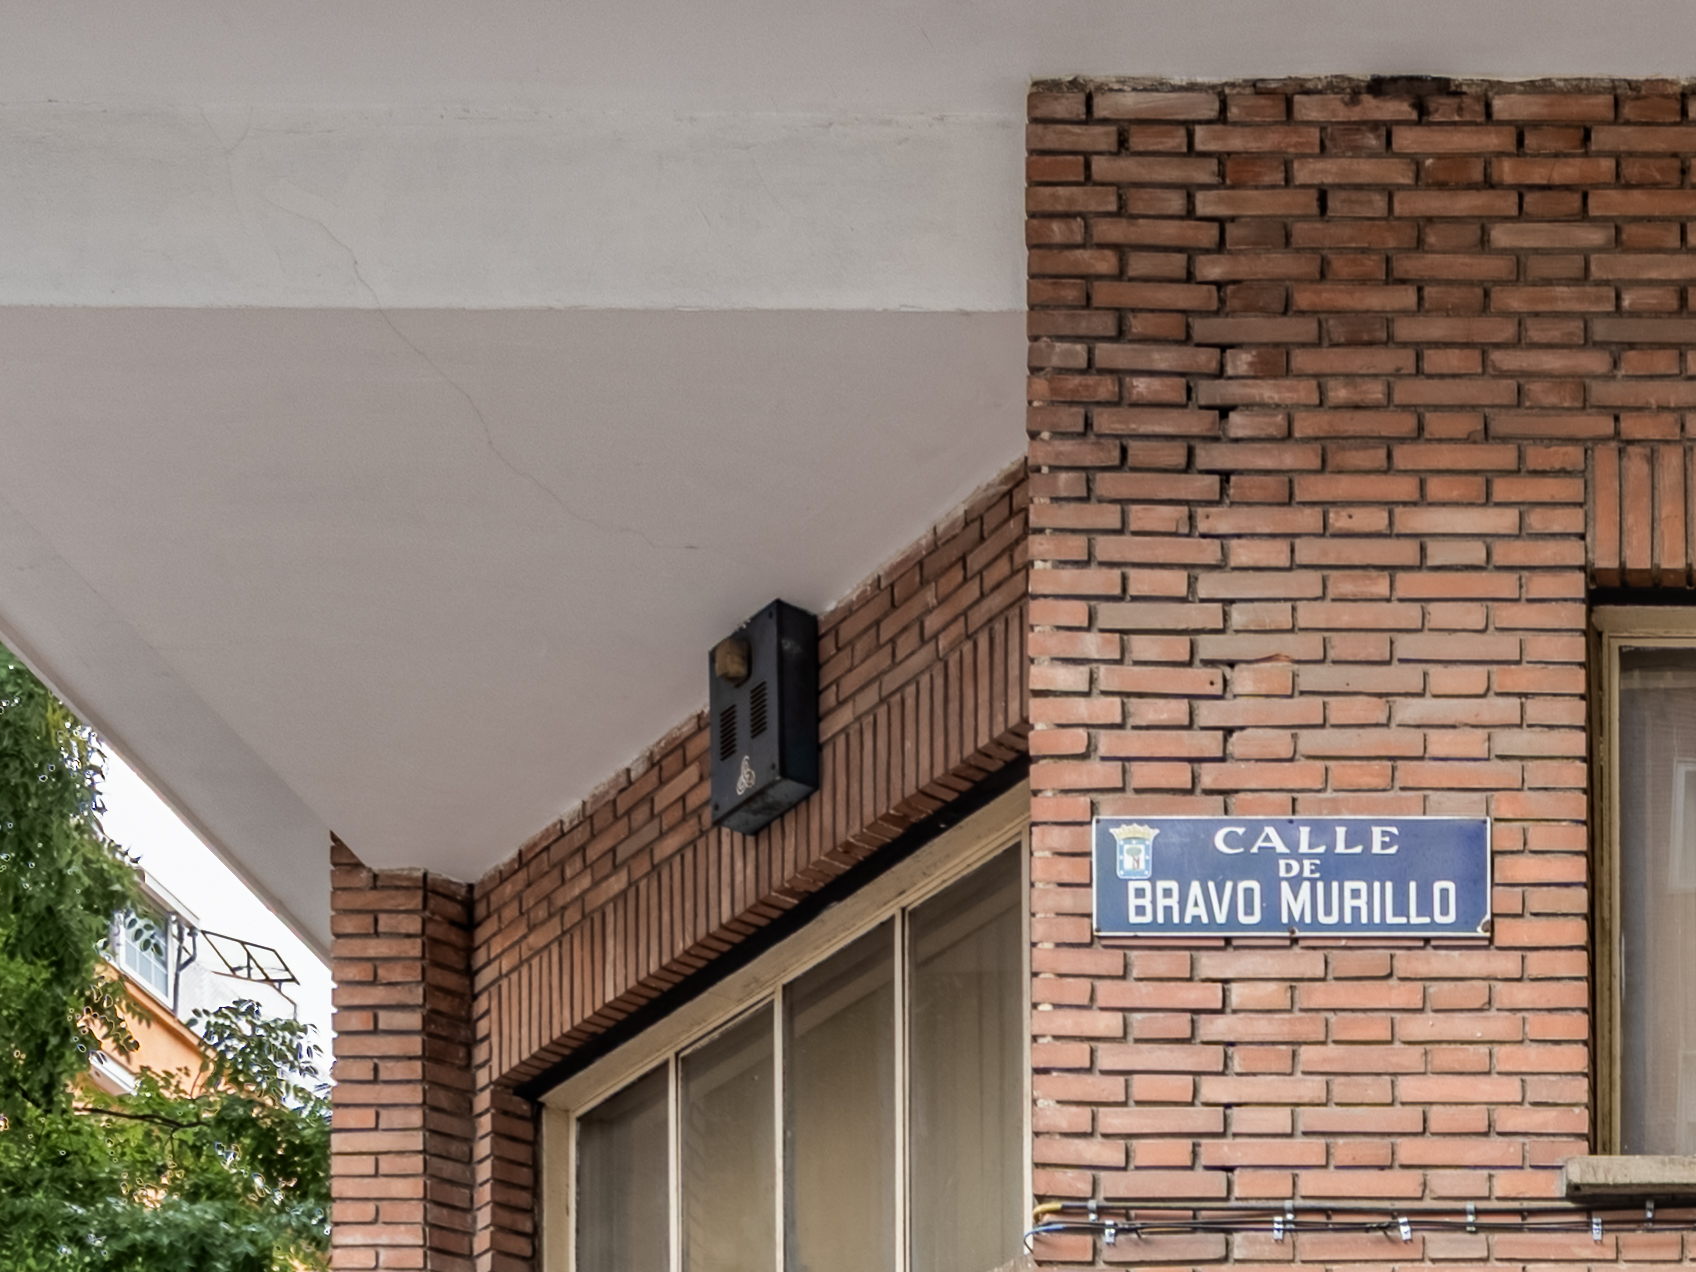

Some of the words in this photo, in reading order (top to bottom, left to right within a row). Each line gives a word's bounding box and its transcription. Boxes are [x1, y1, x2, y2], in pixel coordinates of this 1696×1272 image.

[1212, 824, 1401, 856] CALLE
[1278, 857, 1321, 879] DE
[1127, 879, 1262, 927] BRAVO
[1278, 879, 1457, 927] MURILLO
